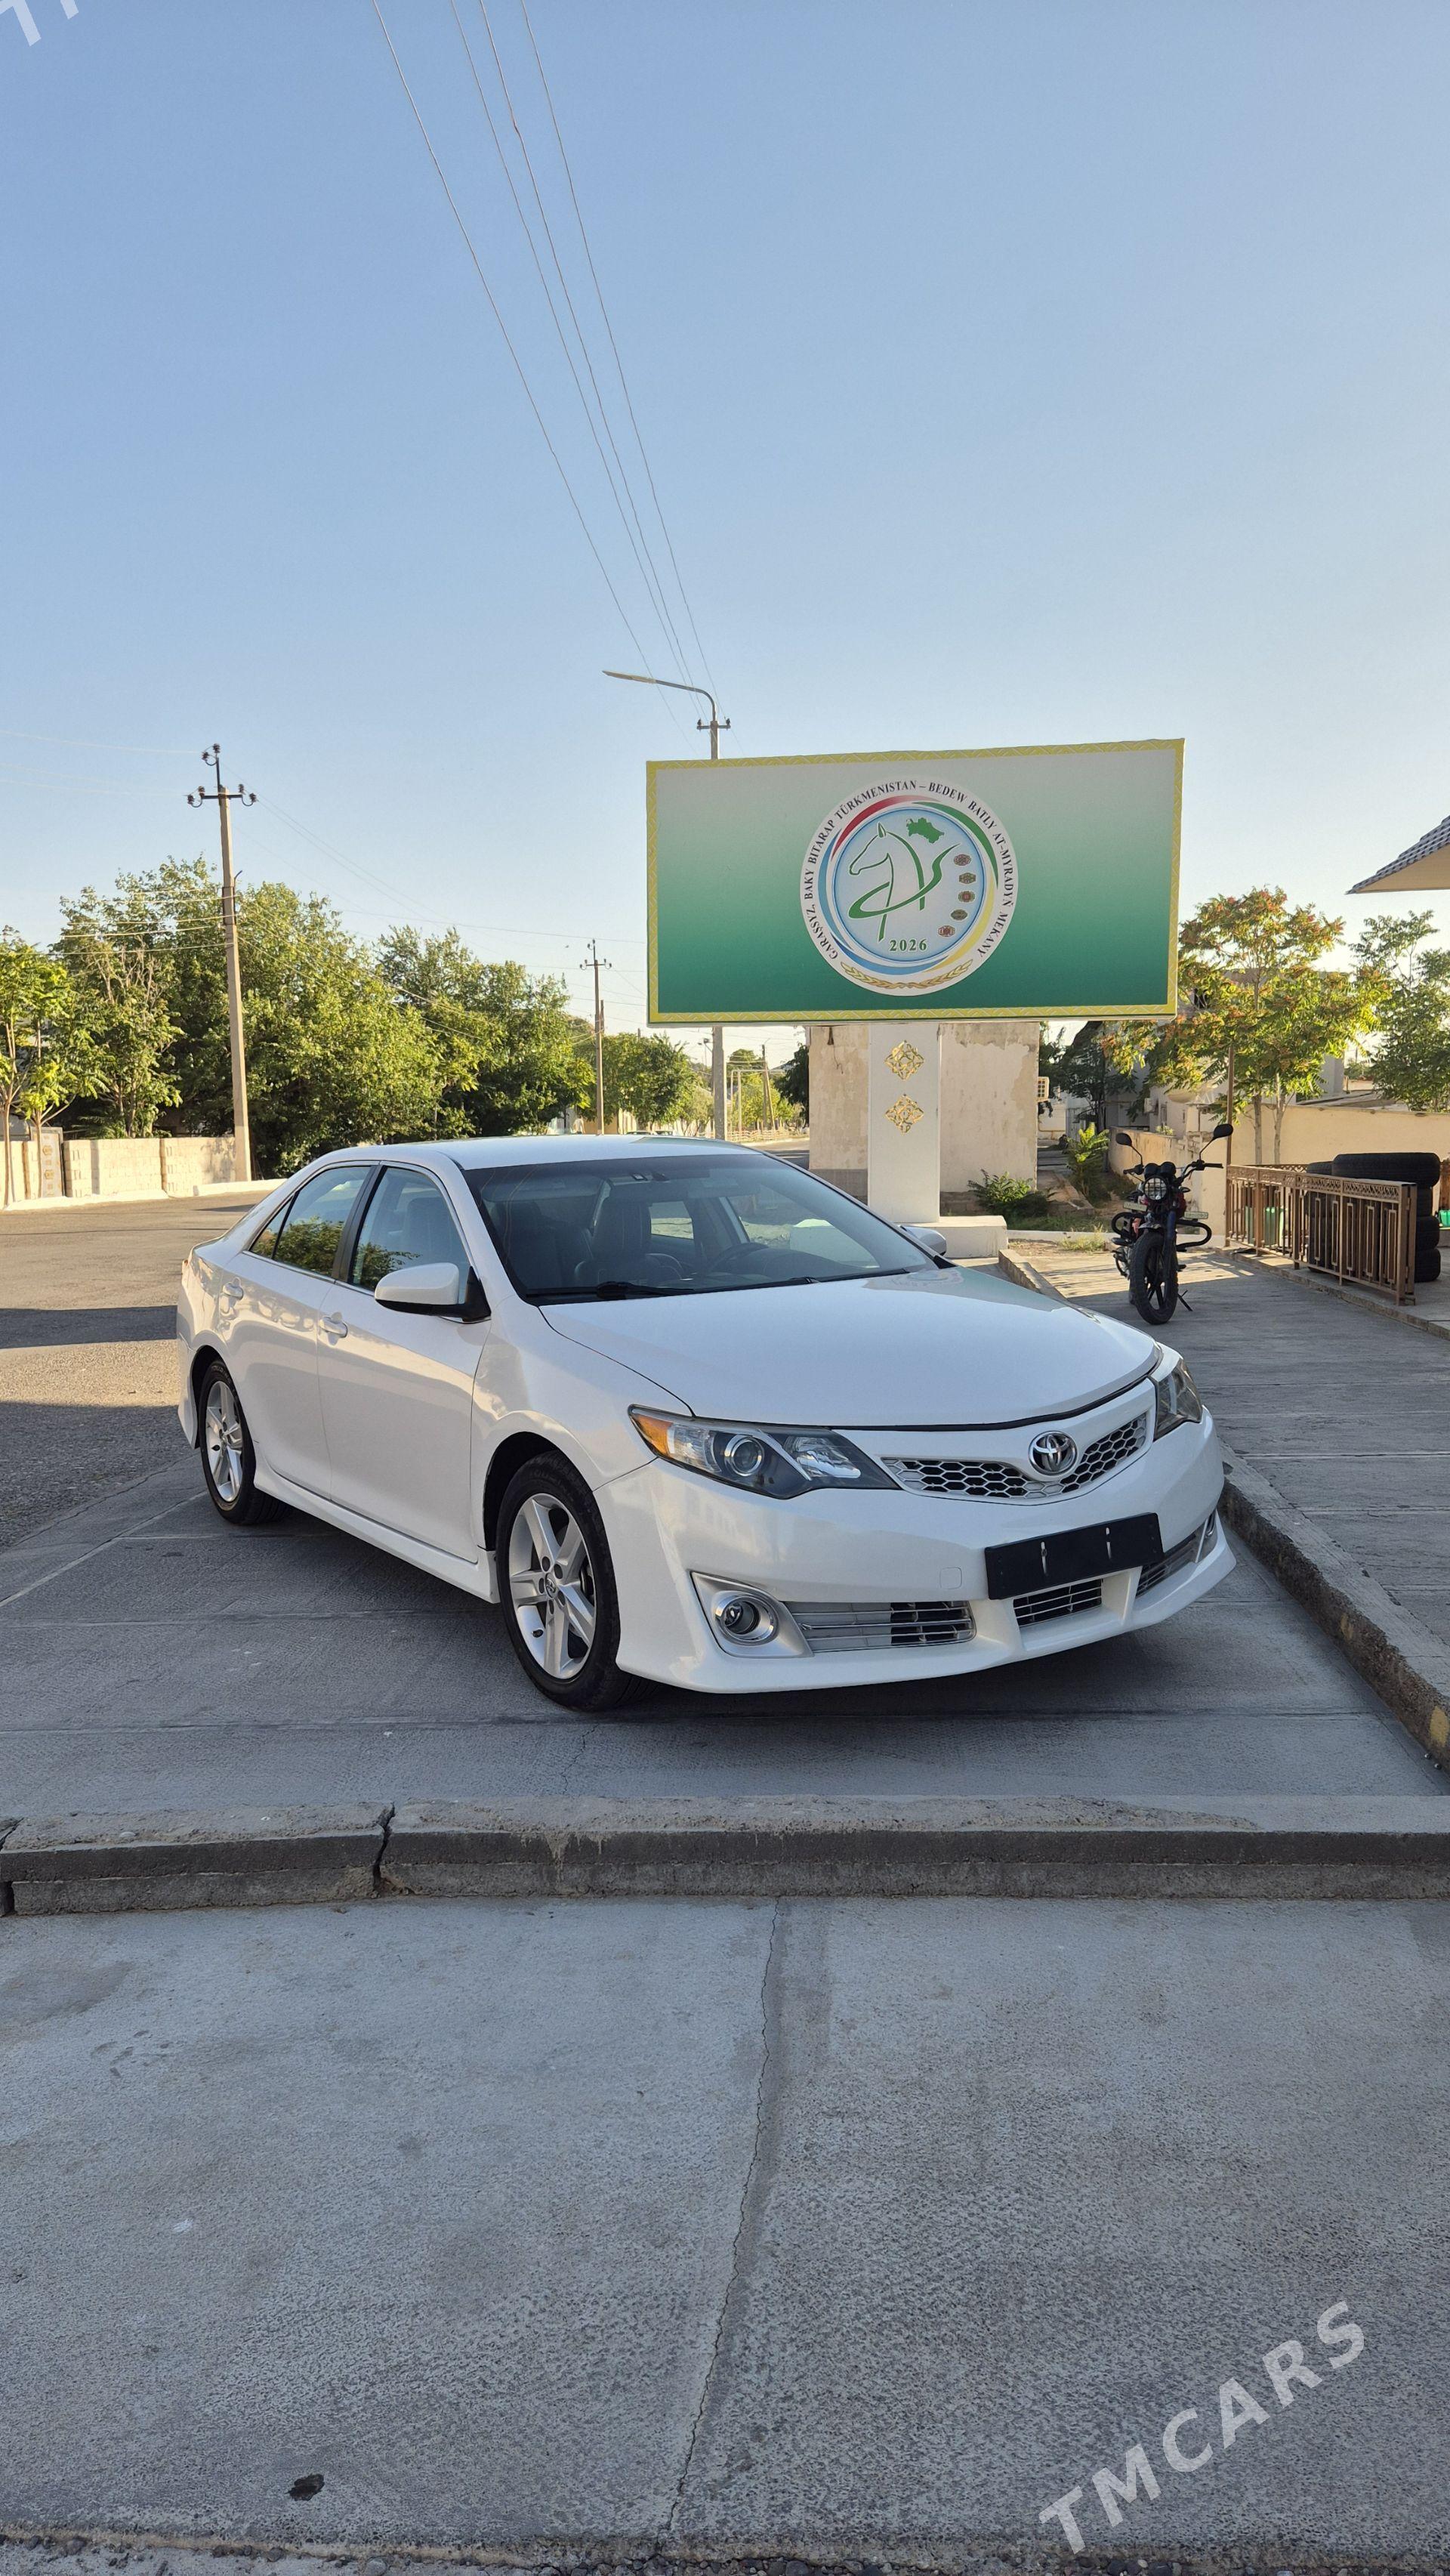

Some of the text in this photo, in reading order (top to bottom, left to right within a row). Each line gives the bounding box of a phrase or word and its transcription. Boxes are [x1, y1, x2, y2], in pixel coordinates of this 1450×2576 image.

[835, 780, 917, 820] TÜRKMENISTAN
[929, 782, 967, 803] BEDEW
[967, 801, 997, 829] BATLY
[807, 820, 836, 864] BITARAP
[804, 869, 815, 900] BAKY
[890, 939, 927, 952] 2026
[977, 912, 1008, 957] MEKANY
